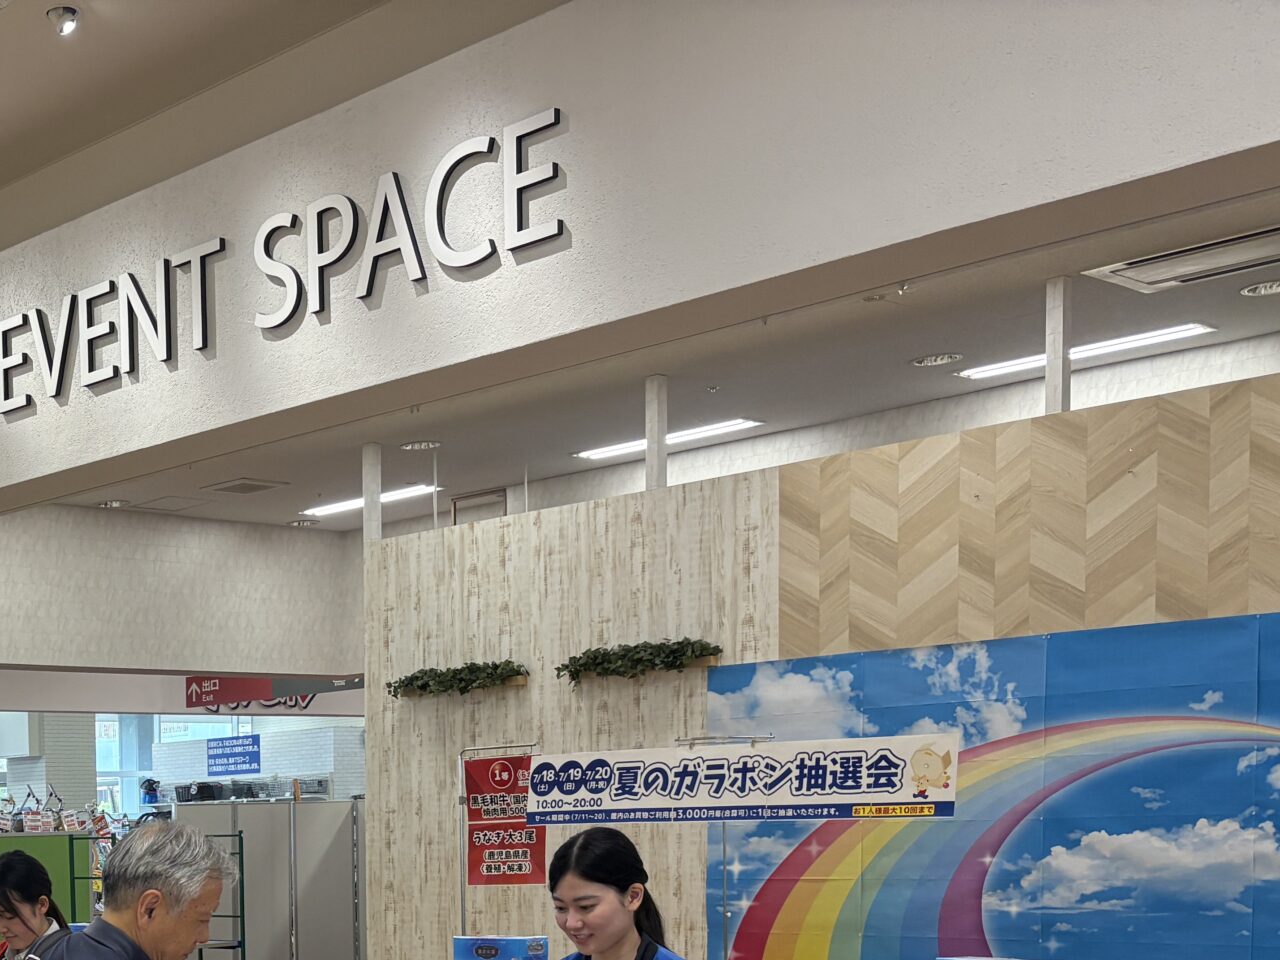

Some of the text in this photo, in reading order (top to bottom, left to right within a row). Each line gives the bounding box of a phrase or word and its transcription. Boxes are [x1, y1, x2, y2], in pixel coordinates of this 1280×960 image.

[253, 107, 563, 329] SPACE
[202, 679, 219, 691] 出口
[202, 694, 214, 702] Exit
[533, 766, 610, 783] 7/18 7/19 7/20
[612, 750, 904, 800] 夏のガラポン抽選会
[474, 831, 503, 844] うなぎ
